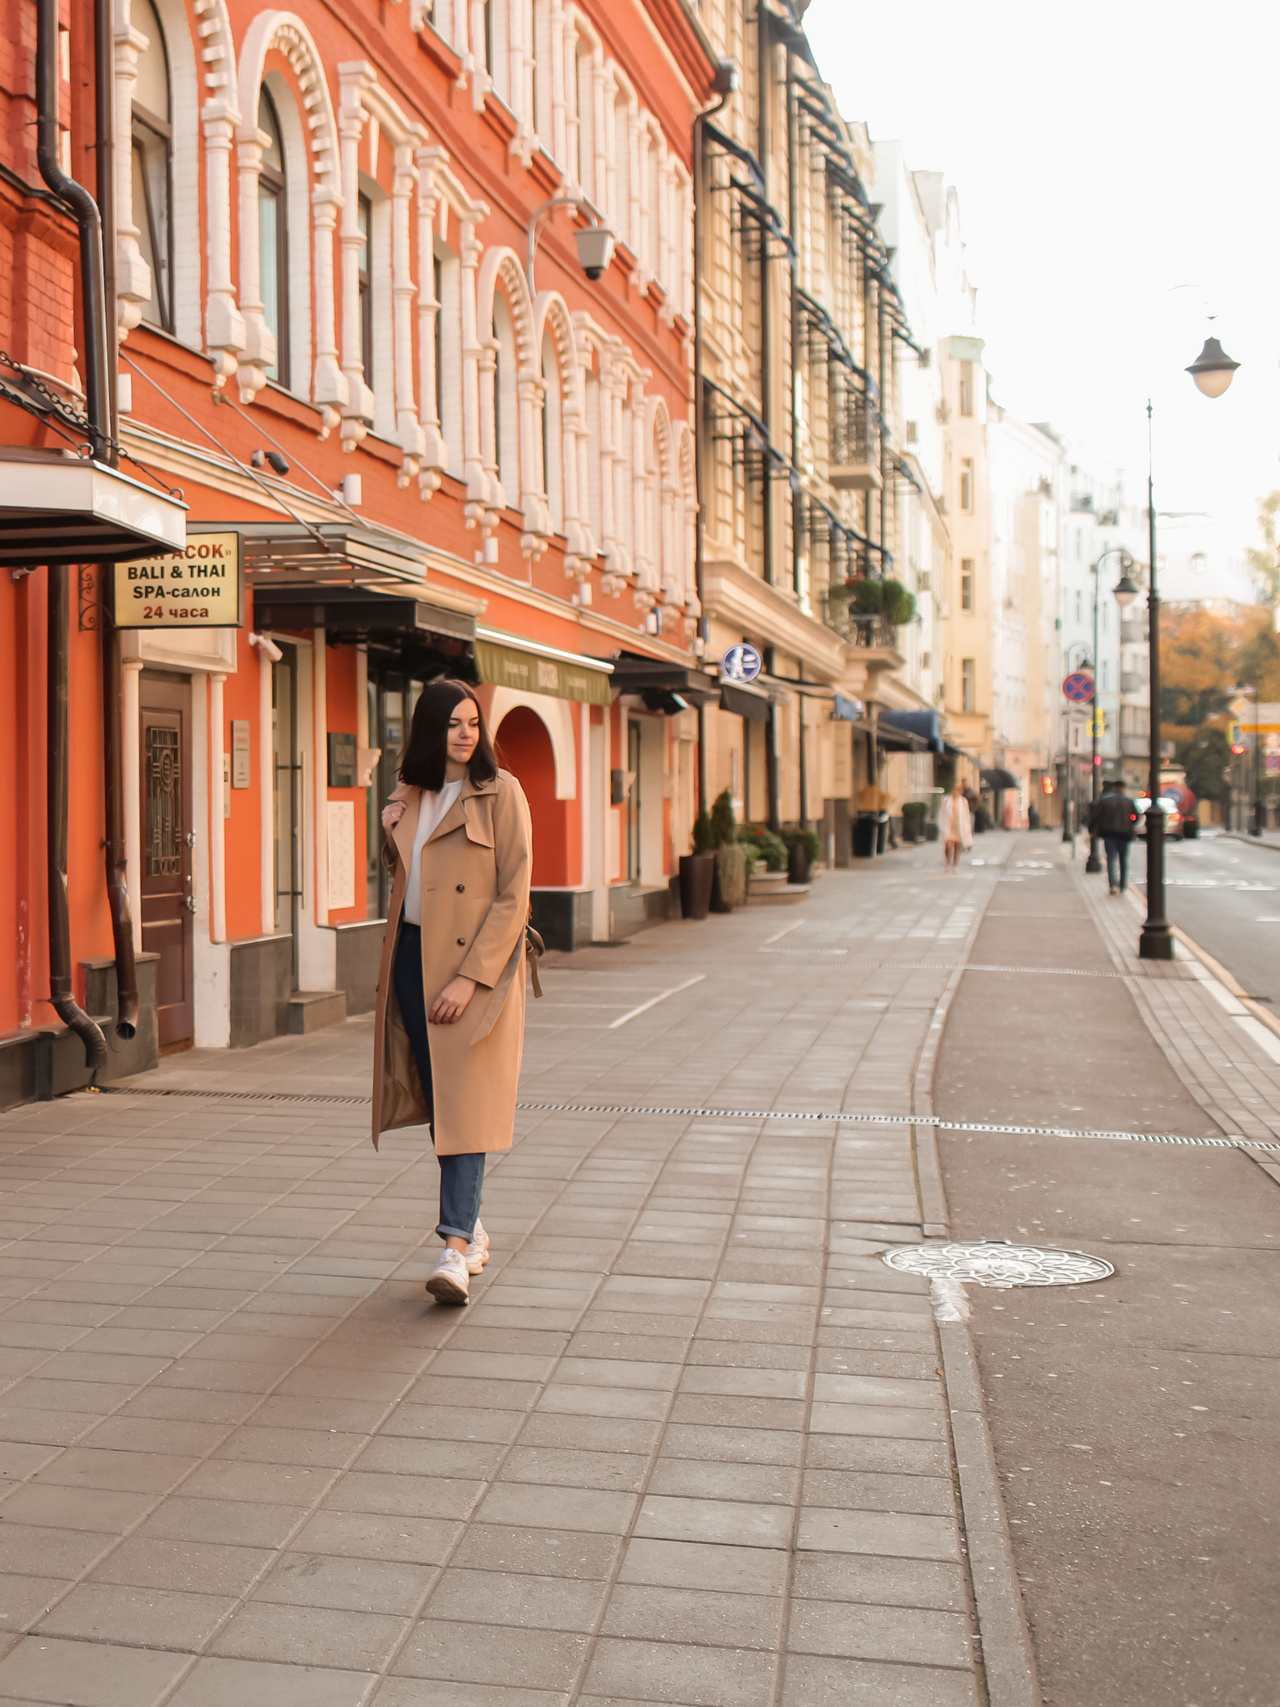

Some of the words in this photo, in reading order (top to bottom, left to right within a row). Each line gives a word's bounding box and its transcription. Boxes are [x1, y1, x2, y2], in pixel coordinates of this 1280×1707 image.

[128, 565, 165, 580] BALI
[170, 565, 183, 579] &
[188, 564, 226, 578] THAI
[133, 585, 221, 599] SPA-салон
[143, 605, 164, 619] 24
[169, 607, 209, 618] часа
